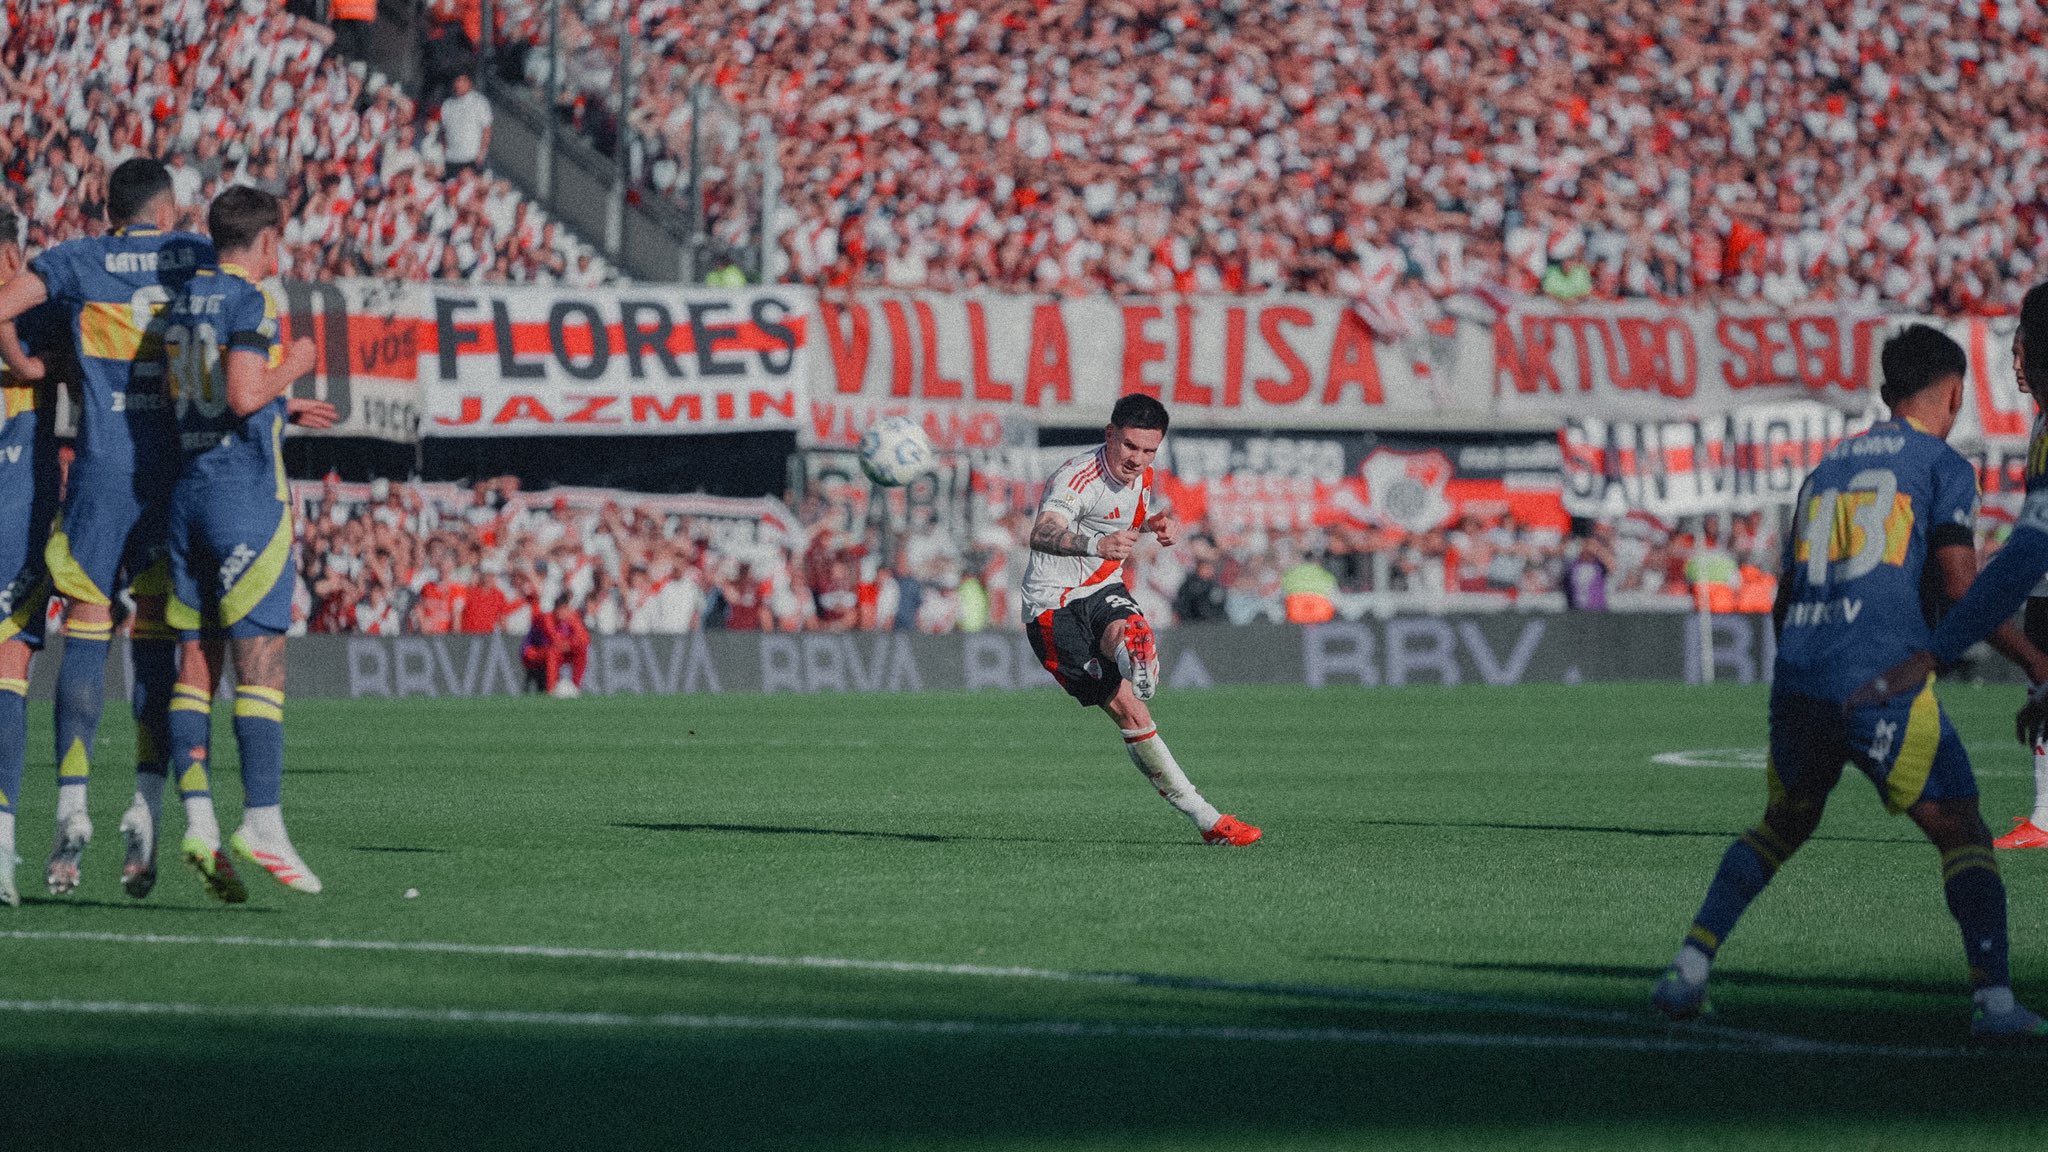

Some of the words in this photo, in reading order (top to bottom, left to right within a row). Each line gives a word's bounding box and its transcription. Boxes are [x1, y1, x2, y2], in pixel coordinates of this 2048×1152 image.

[435, 298, 796, 380] FLORES
[819, 299, 1073, 407] VILLA
[1121, 303, 1385, 407] ELISA
[1716, 316, 1876, 392] SEGU
[435, 391, 795, 426] JAZMIN
[582, 633, 722, 696] BVA
